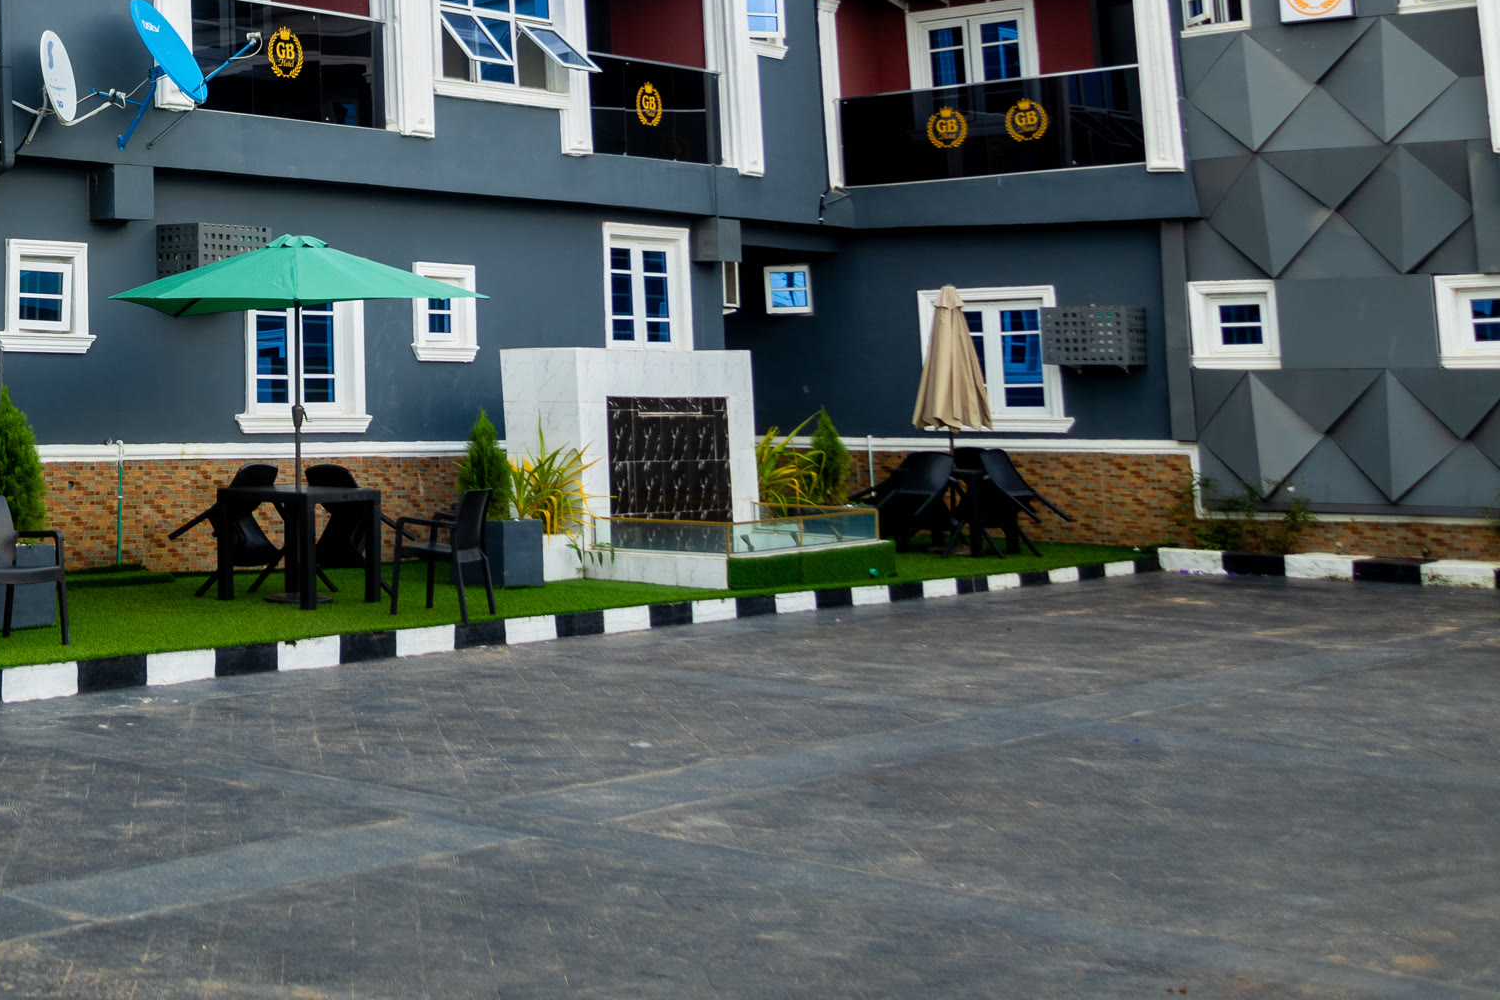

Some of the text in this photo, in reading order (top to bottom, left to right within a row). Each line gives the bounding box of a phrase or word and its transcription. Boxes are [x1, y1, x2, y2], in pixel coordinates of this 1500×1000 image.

[276, 42, 296, 59] GB
[642, 95, 656, 110] GB
[936, 119, 958, 133] GB
[1015, 111, 1038, 126] GB
